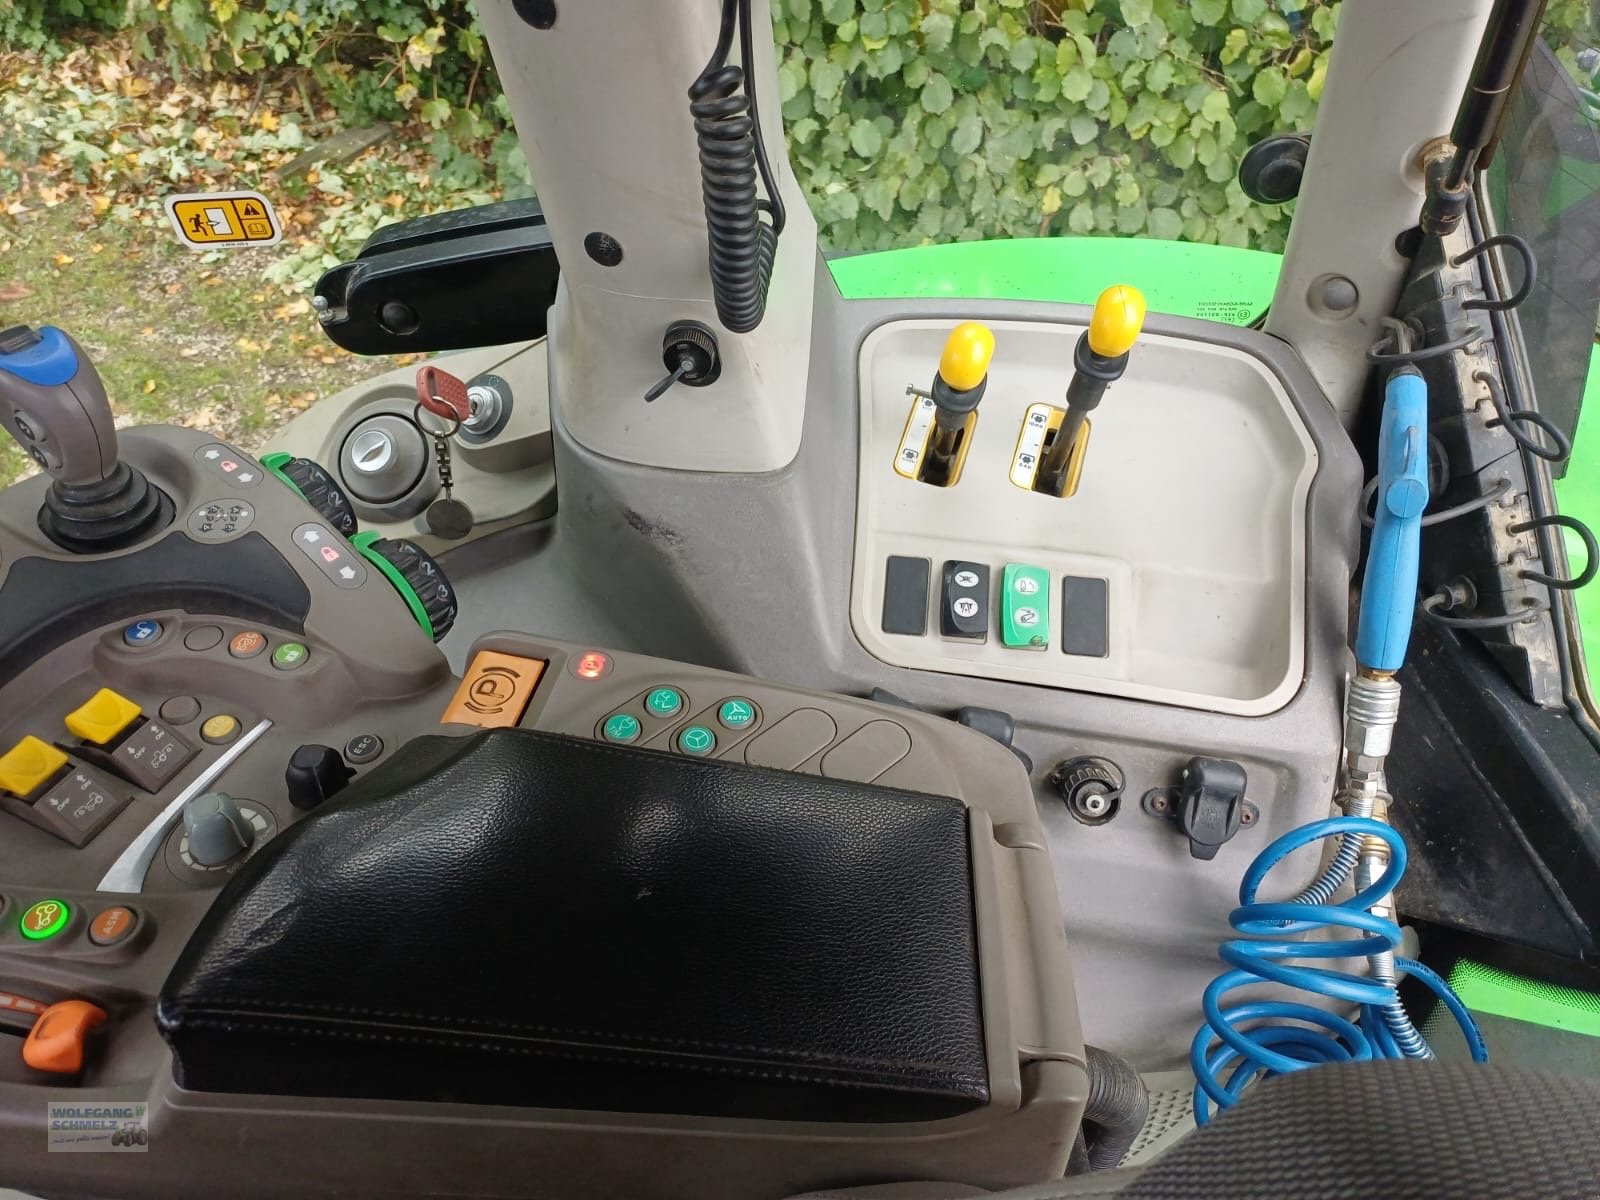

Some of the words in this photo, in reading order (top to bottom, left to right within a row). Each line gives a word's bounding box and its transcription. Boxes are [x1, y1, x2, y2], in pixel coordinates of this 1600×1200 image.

[315, 471, 326, 481] 1
[330, 491, 343, 507] 2
[343, 514, 352, 527] 3
[405, 545, 416, 553] 1
[422, 561, 435, 576] 2
[438, 584, 449, 598] 3
[475, 679, 505, 699] P
[353, 737, 372, 754] ESC
